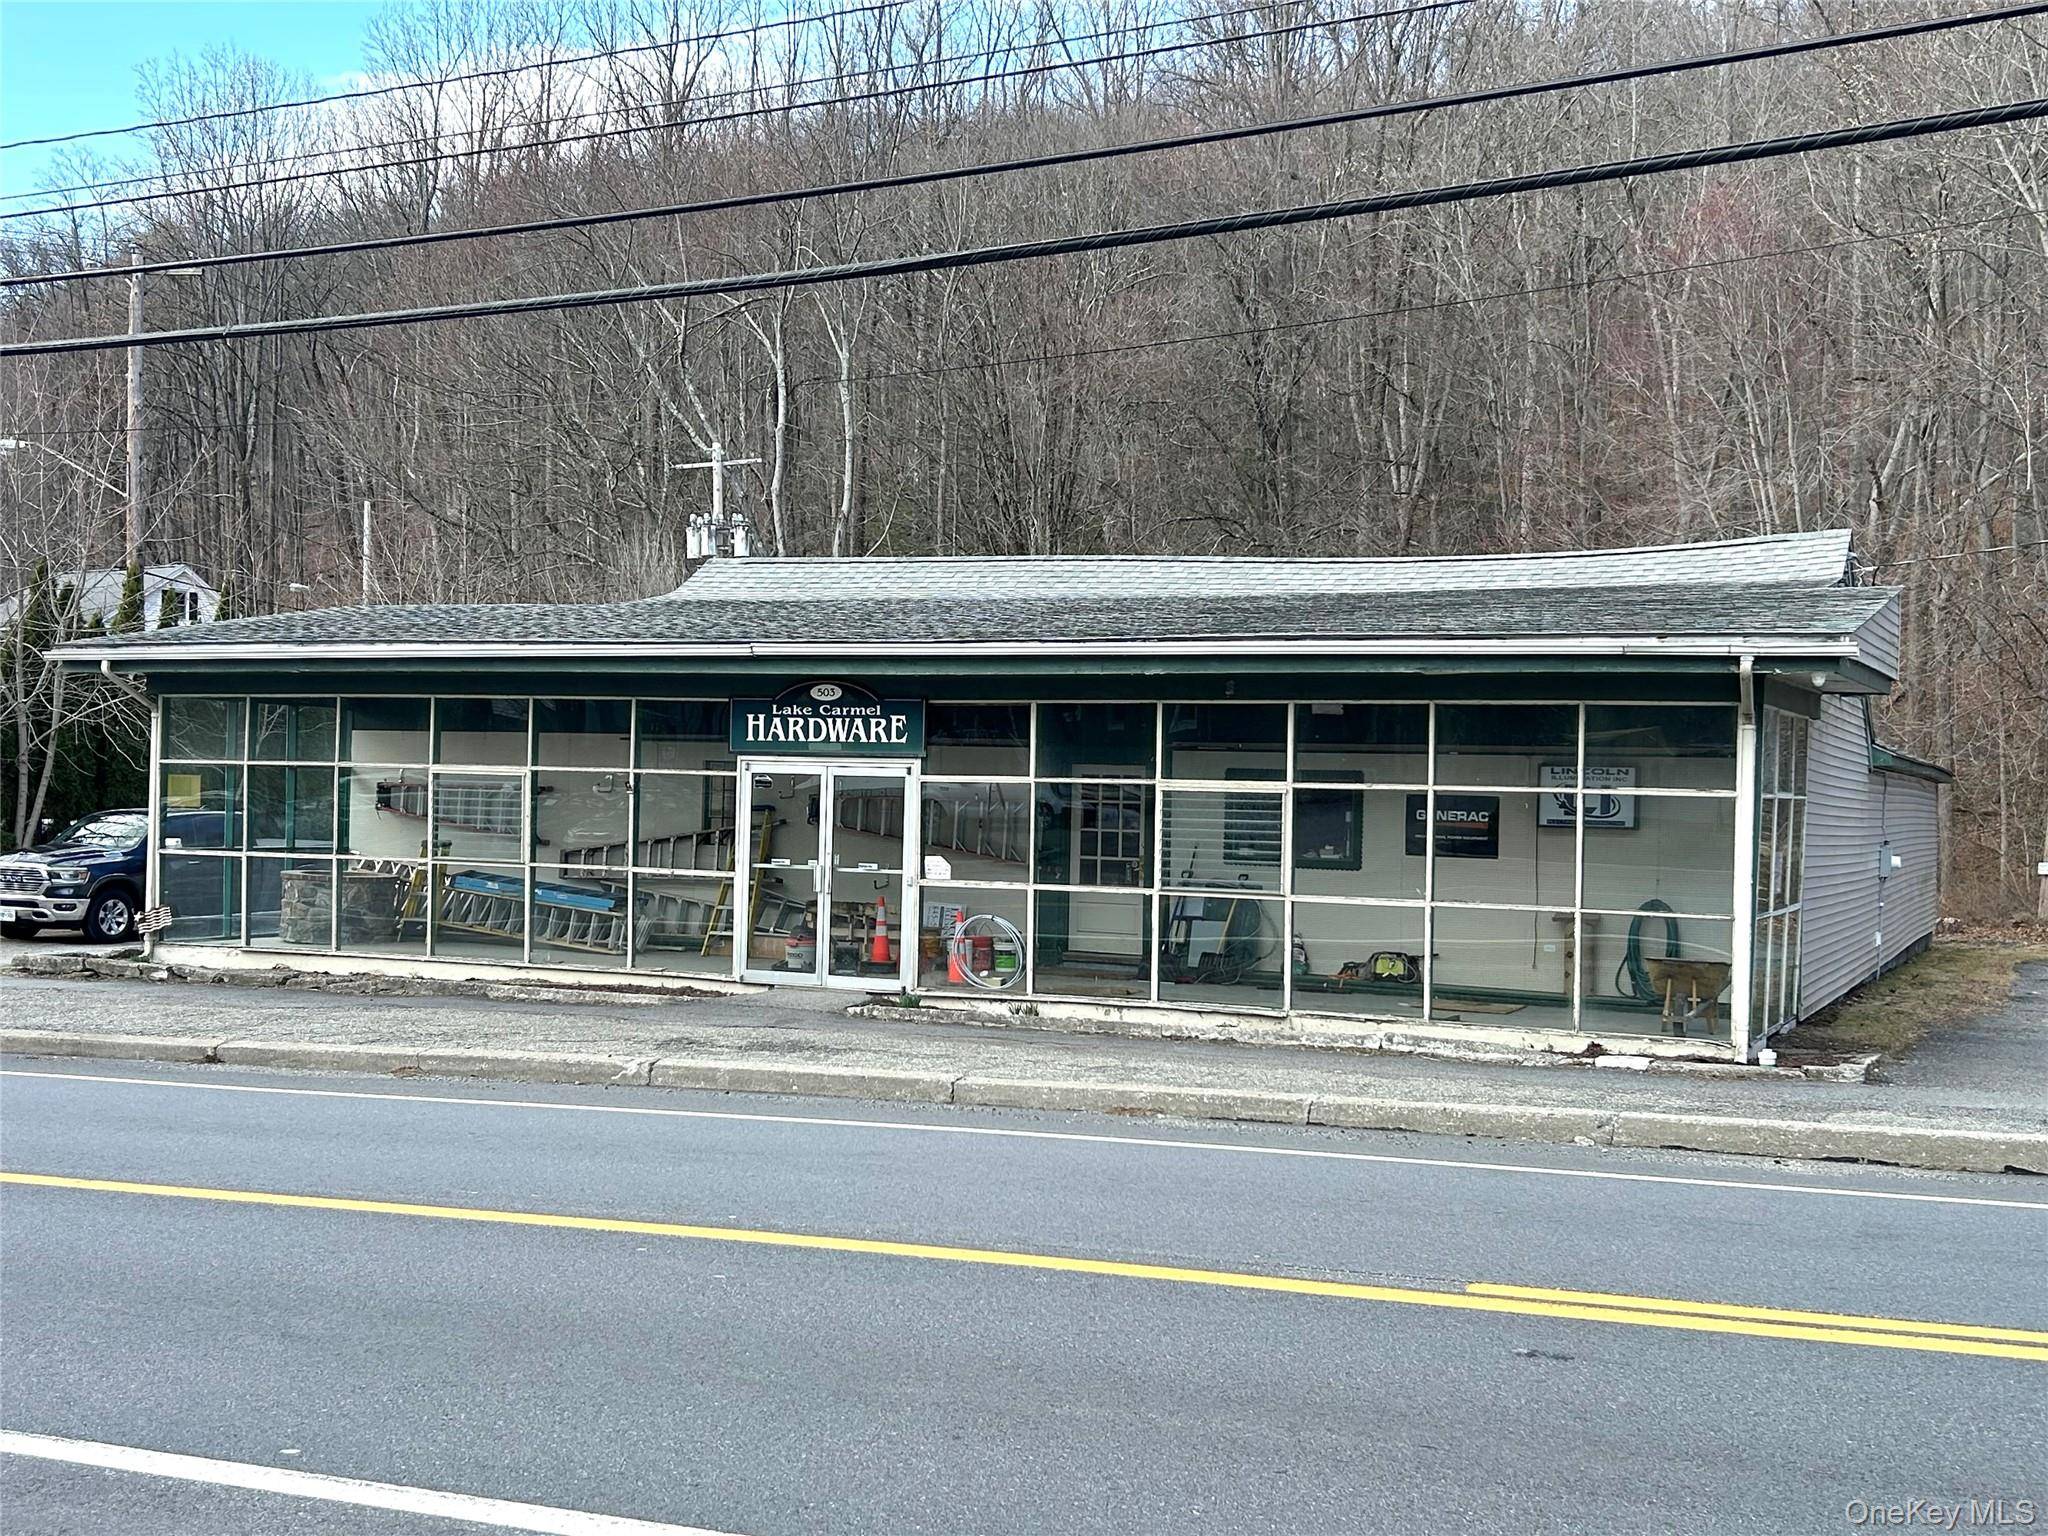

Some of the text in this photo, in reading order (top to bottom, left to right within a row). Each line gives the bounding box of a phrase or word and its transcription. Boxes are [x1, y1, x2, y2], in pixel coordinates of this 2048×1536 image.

[816, 687, 836, 698] 503
[772, 704, 882, 716] Lake Carmel
[746, 713, 909, 744] HARDWARE
[1415, 809, 1490, 822] GNERAC
